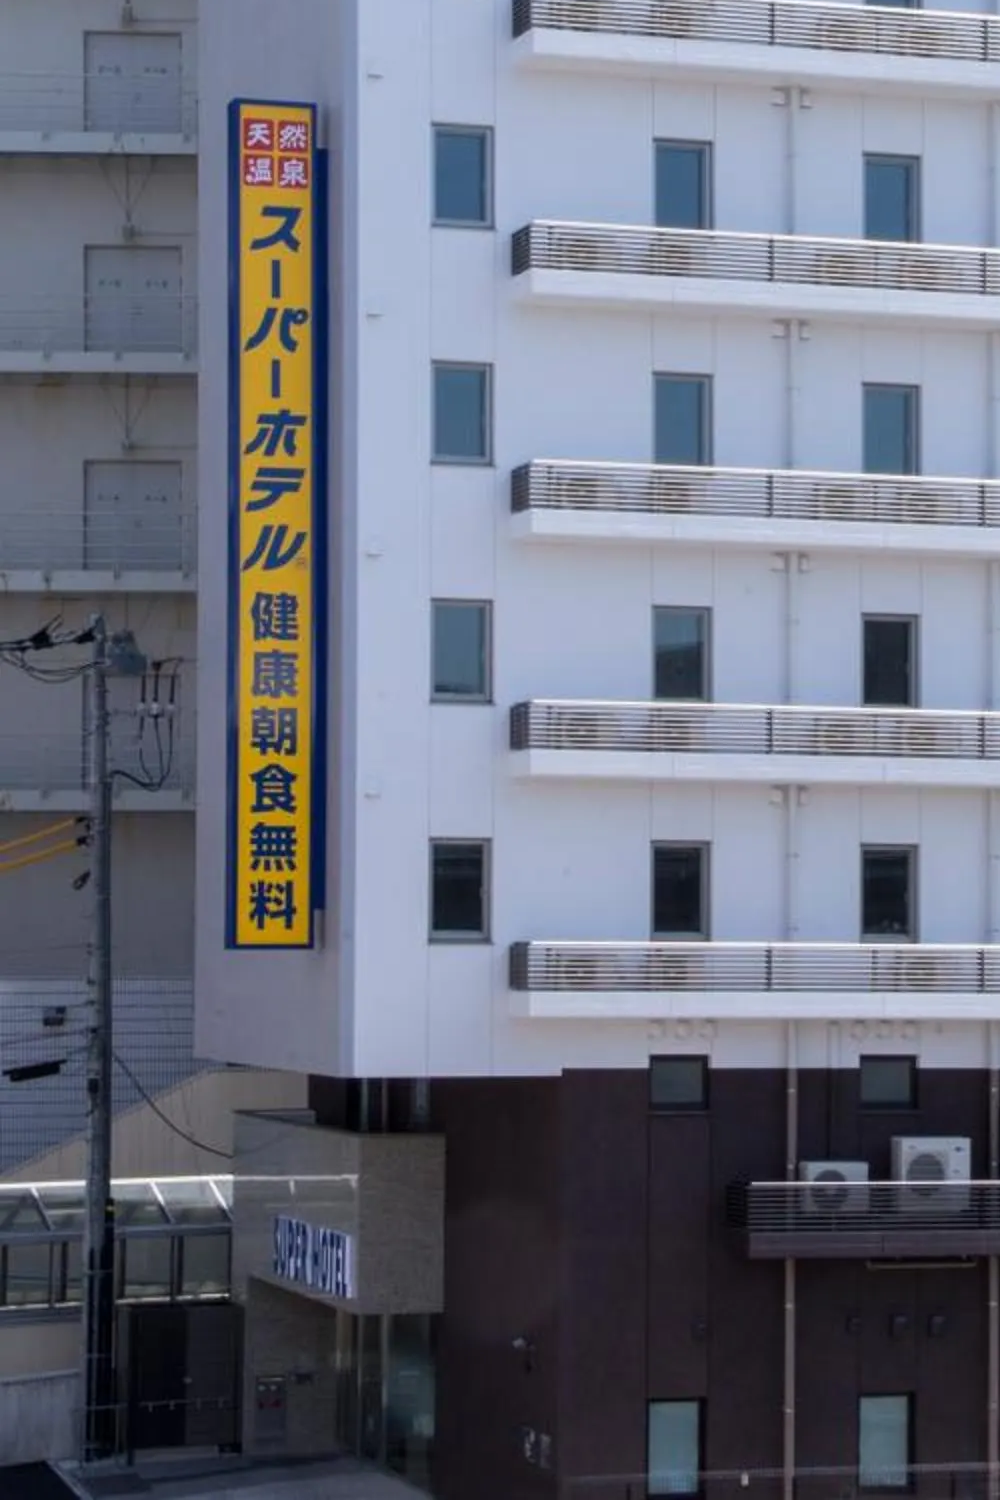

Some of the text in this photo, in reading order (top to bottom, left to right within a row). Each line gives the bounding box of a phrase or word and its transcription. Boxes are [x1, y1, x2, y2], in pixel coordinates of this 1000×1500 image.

[242, 206, 308, 571] スーパーホテル
[249, 591, 300, 931] 健康朝食無料
[273, 1214, 353, 1299] SUPER HOTEL
